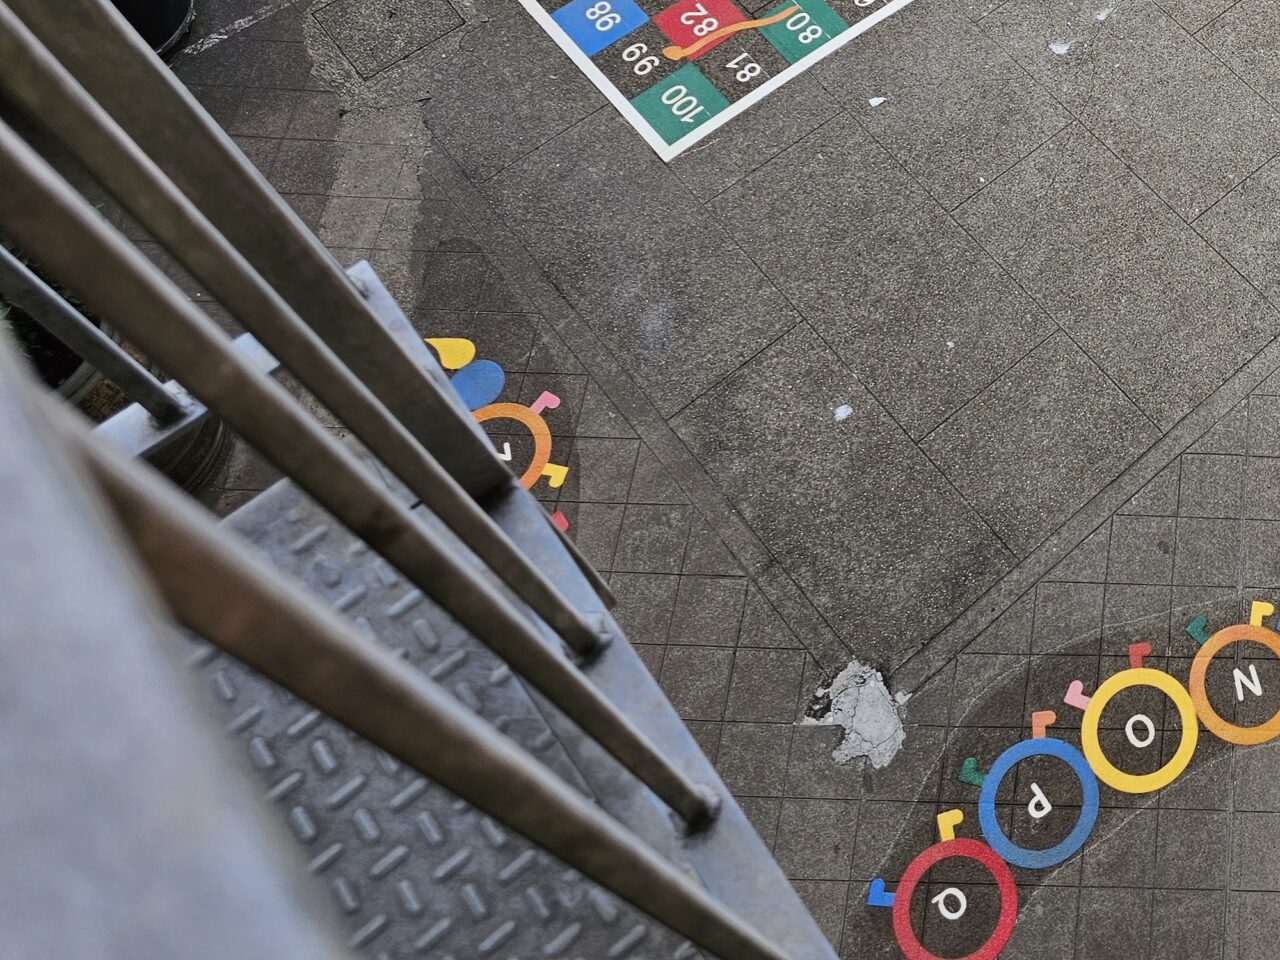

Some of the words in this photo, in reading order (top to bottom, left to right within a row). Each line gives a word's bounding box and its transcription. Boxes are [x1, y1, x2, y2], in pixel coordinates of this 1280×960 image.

[585, 1, 622, 32] 98
[680, 3, 719, 37] 82
[785, 12, 823, 44] 80
[622, 43, 660, 76] 99
[725, 52, 762, 82] 81
[661, 85, 705, 123] 100
[1232, 664, 1263, 702] N
[1124, 713, 1156, 748] O
[1027, 782, 1053, 819] P
[931, 887, 967, 920] Q
